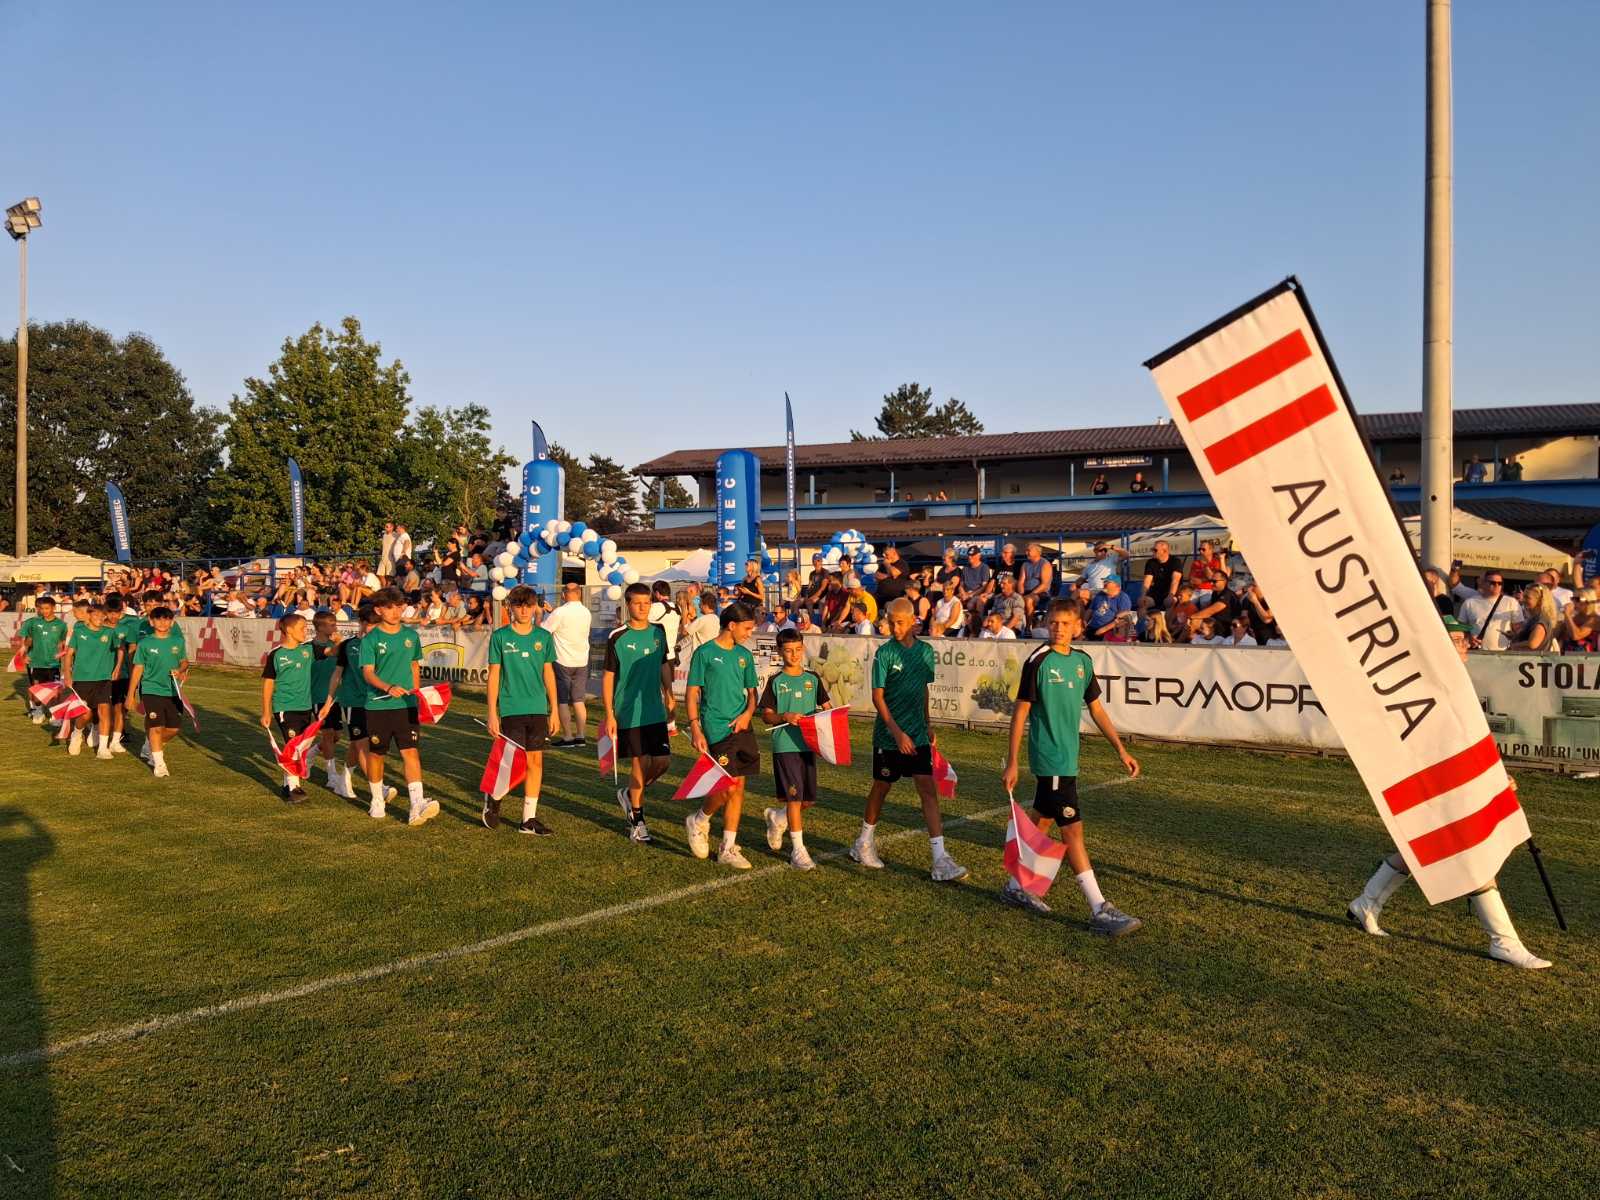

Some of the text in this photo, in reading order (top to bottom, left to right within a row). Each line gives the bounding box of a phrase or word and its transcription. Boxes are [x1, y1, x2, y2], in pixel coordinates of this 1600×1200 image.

[1272, 480, 1437, 741] AUSTRIJA
[1512, 744, 1530, 756] PO
[1532, 745, 1571, 759] MJERI
